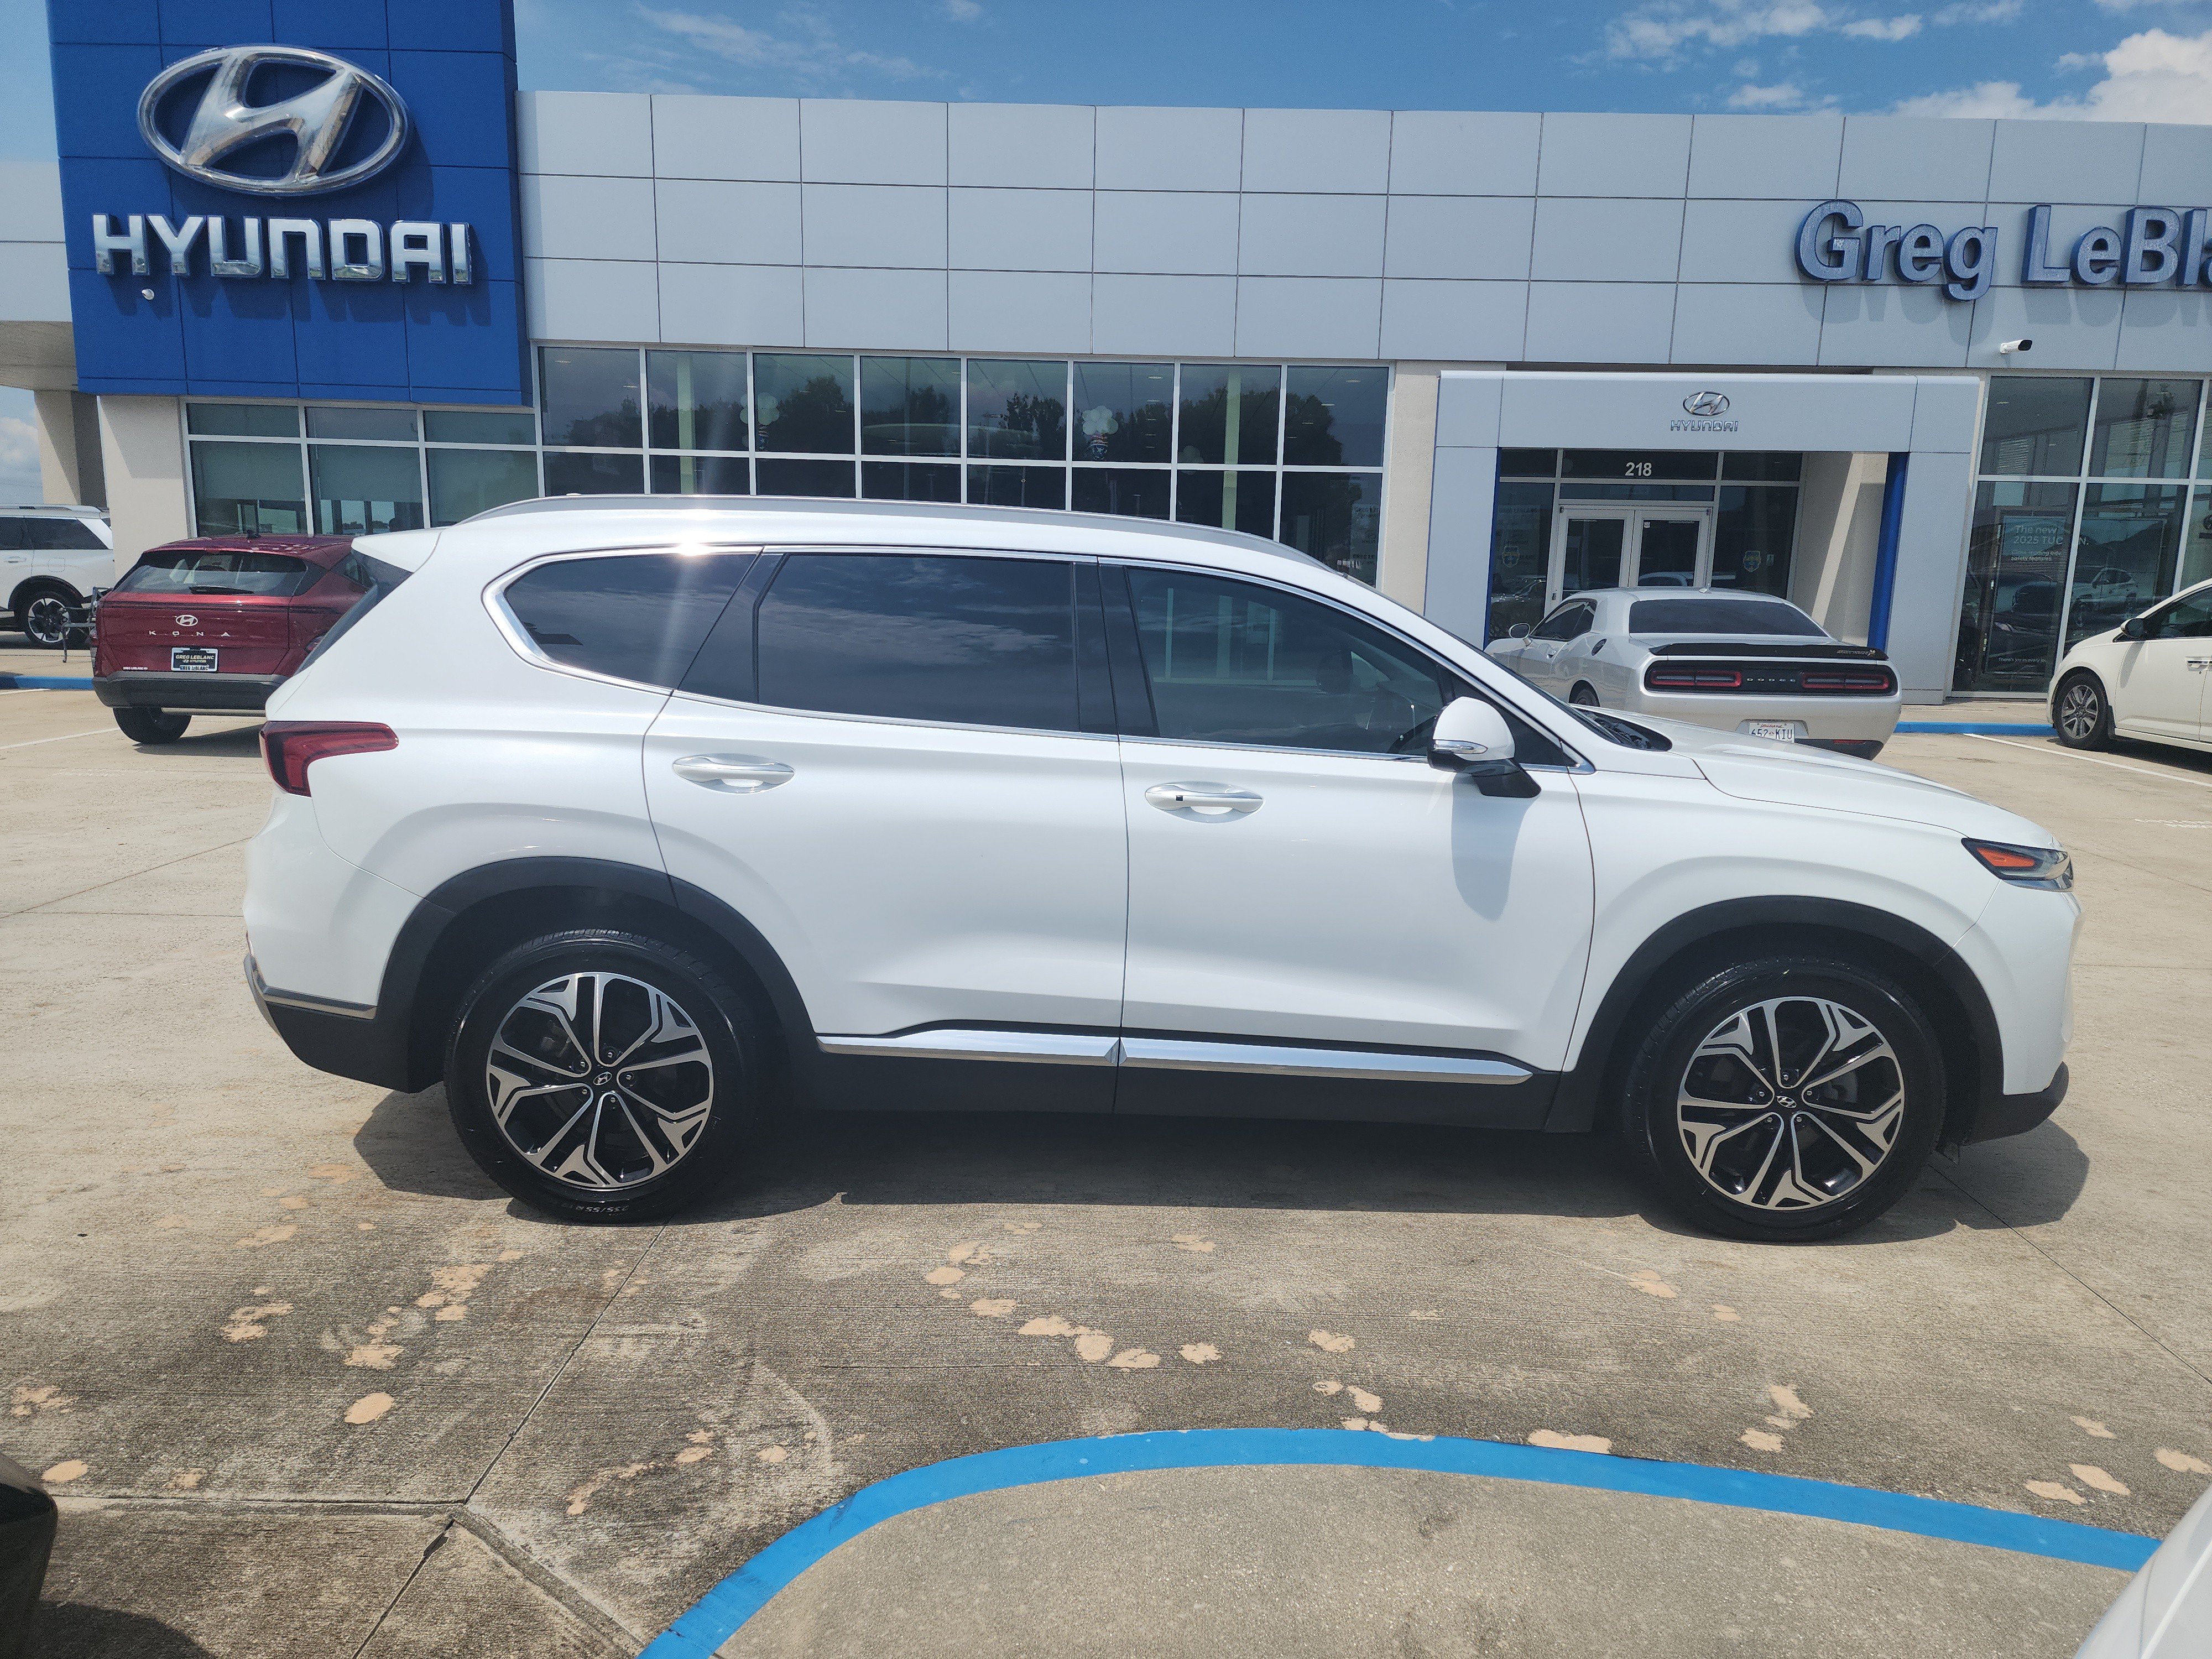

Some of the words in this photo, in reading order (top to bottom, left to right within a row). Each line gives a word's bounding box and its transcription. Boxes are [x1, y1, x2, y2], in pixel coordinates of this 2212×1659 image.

[92, 213, 472, 285] HYUNDAI
[1794, 200, 1998, 302] Greg
[1670, 420, 1738, 431] HYUNDAI
[1625, 462, 1652, 476] 218
[2015, 525, 2032, 534] The
[2013, 536, 2039, 544] 2025
[1775, 729, 1792, 740] KIU
